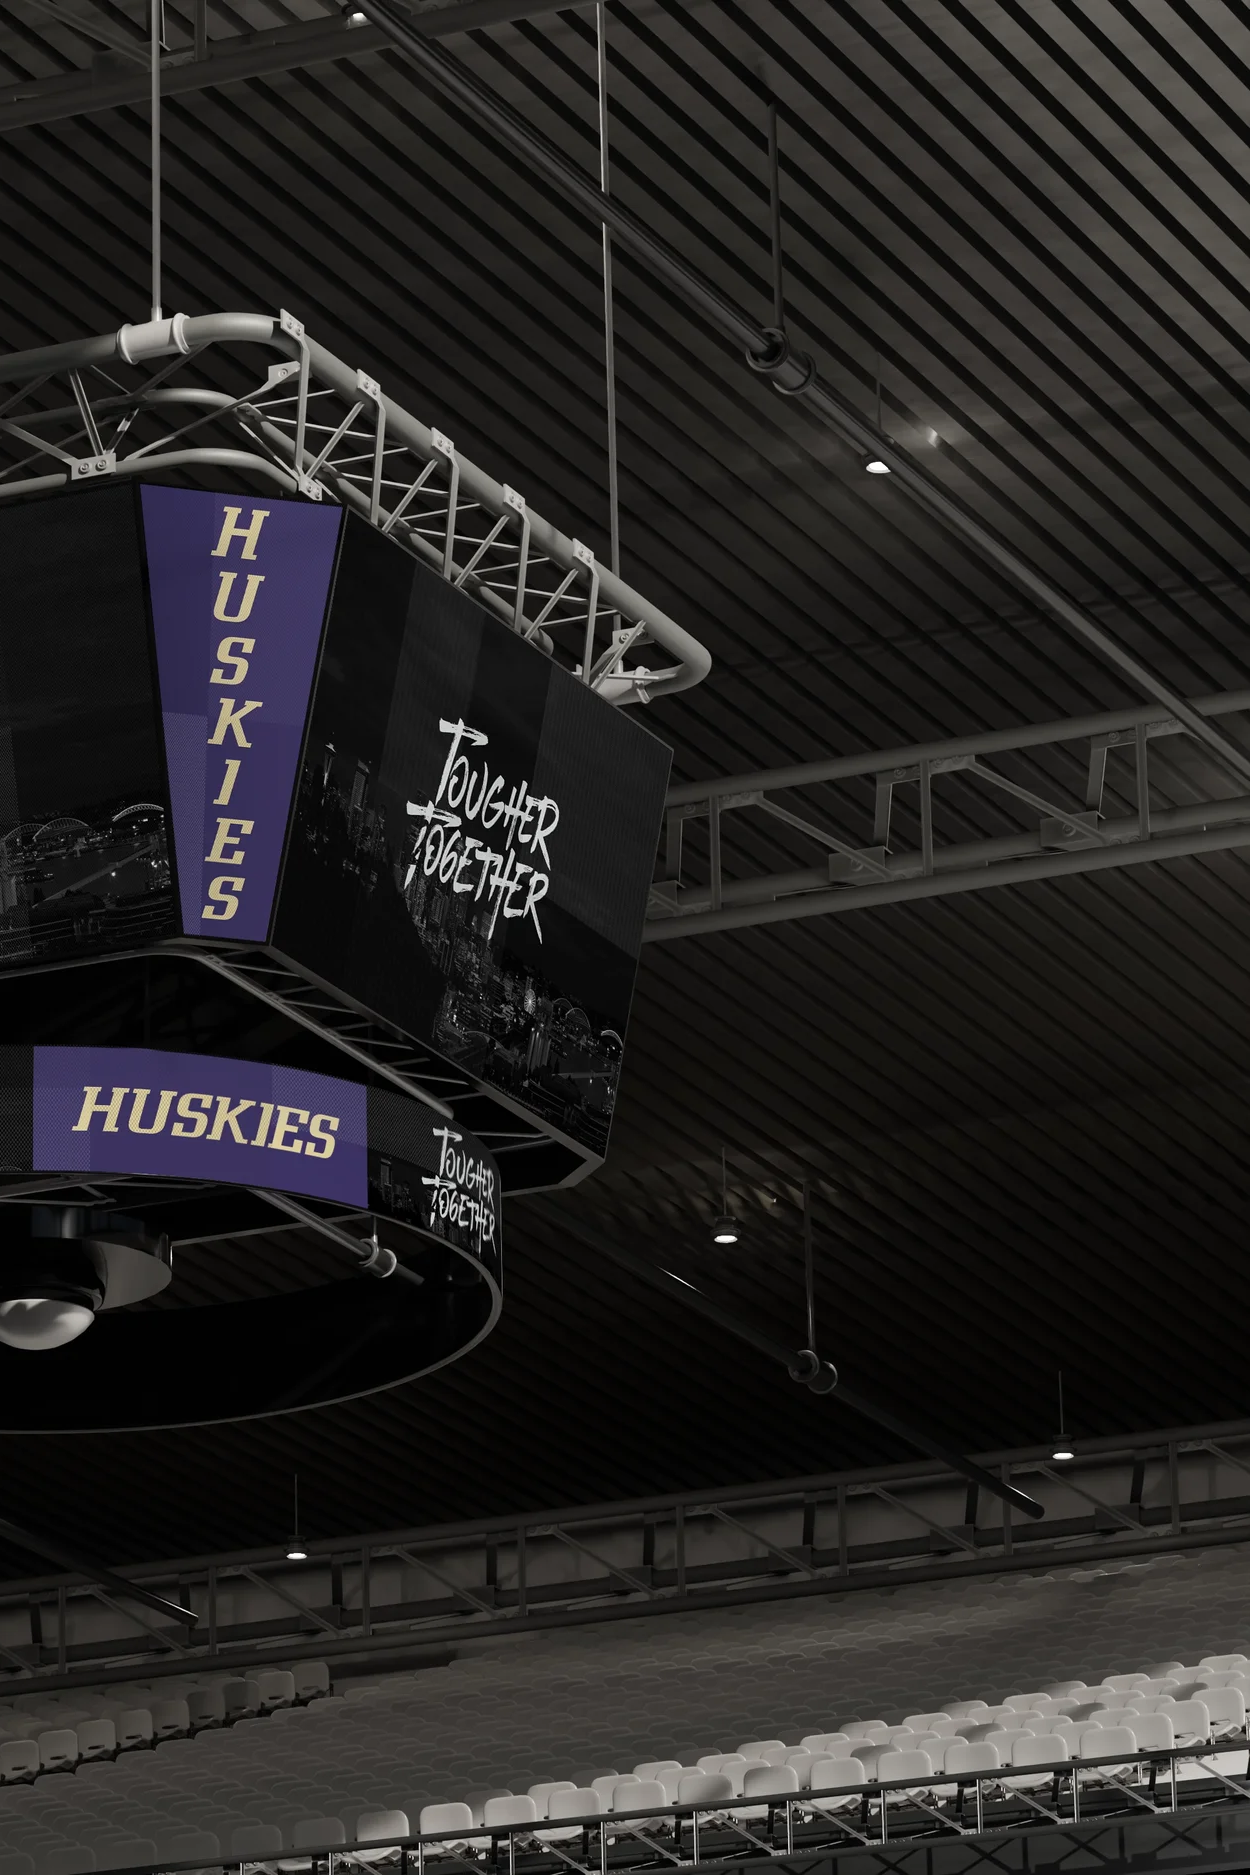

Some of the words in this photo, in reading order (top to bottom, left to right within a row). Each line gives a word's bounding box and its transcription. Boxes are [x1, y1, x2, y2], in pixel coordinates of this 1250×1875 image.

[202, 506, 270, 921] HUSKIES
[435, 718, 559, 871] TOUGHER
[404, 800, 550, 945] TOGETHER
[71, 1086, 340, 1160] HUSKIES
[432, 1126, 495, 1214] TOUGHER
[421, 1174, 497, 1259] TOGETHER
